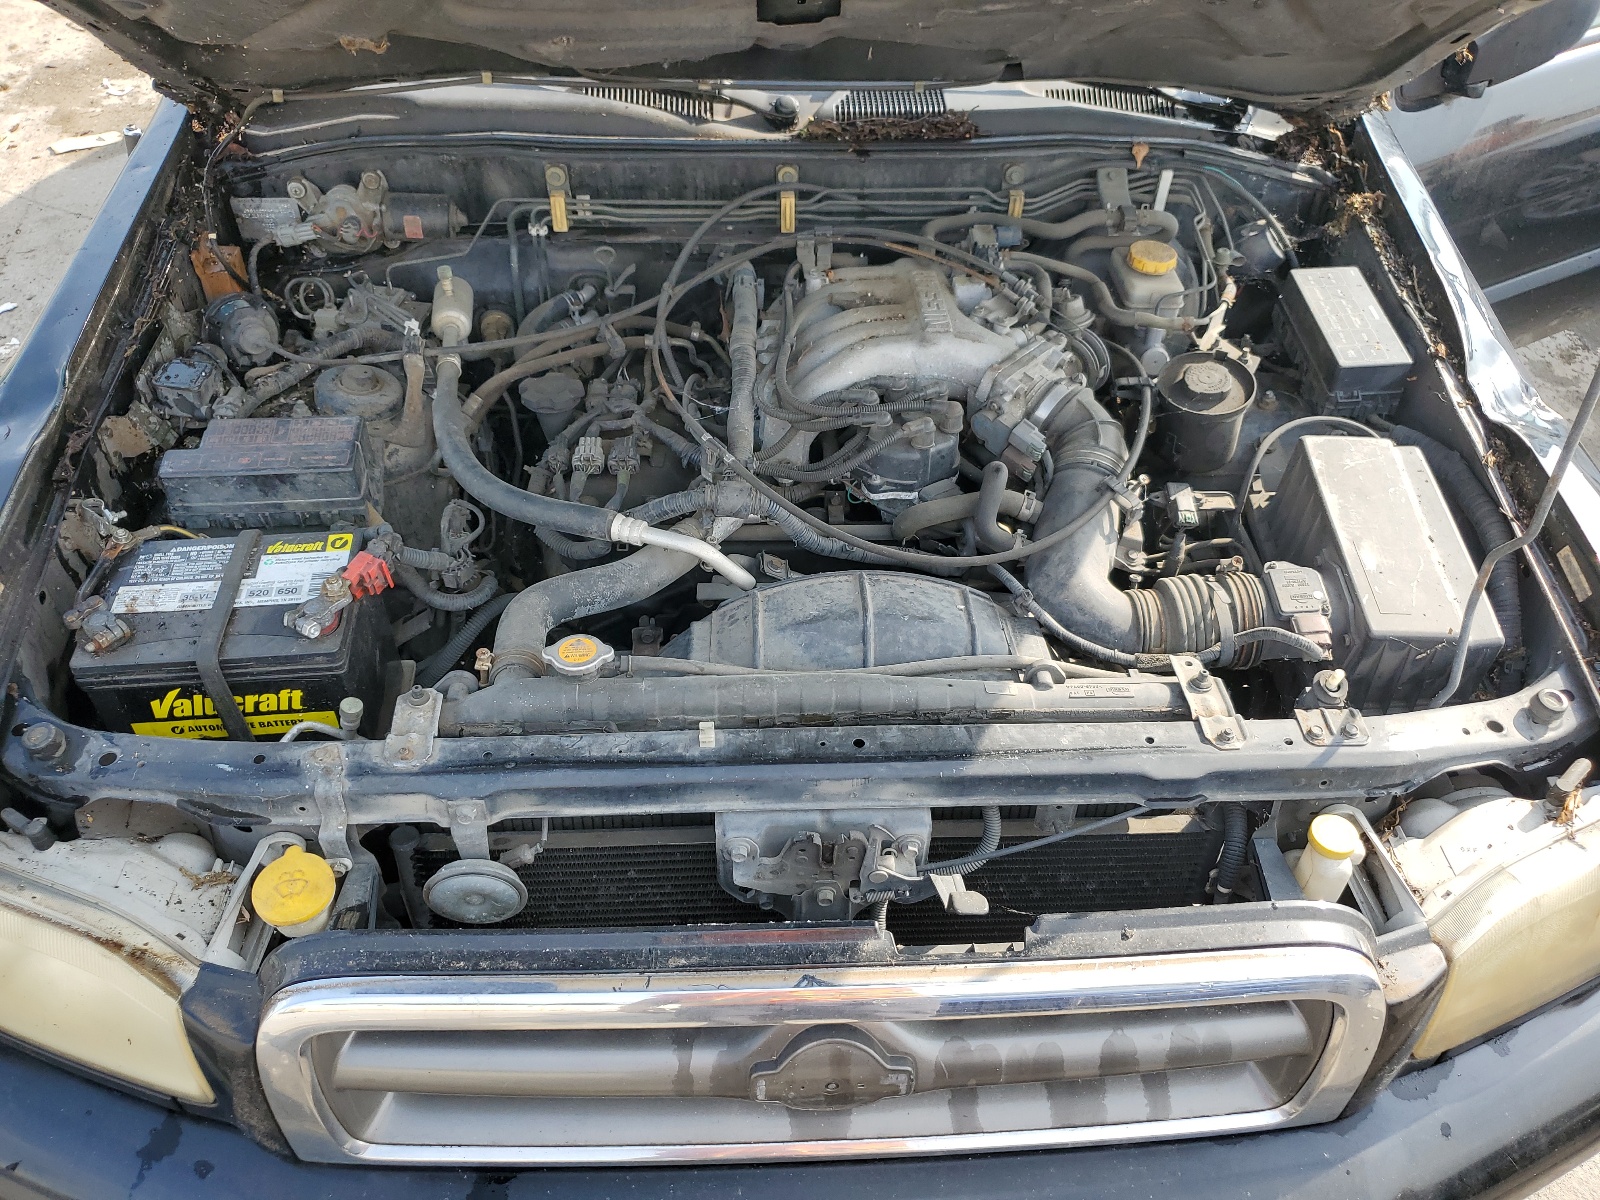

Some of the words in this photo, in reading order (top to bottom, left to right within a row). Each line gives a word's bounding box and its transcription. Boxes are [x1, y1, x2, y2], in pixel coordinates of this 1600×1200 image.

[266, 541, 325, 554] Valucraft
[248, 589, 269, 597] 520
[277, 587, 298, 595] 650
[259, 719, 304, 728] BATTERY
